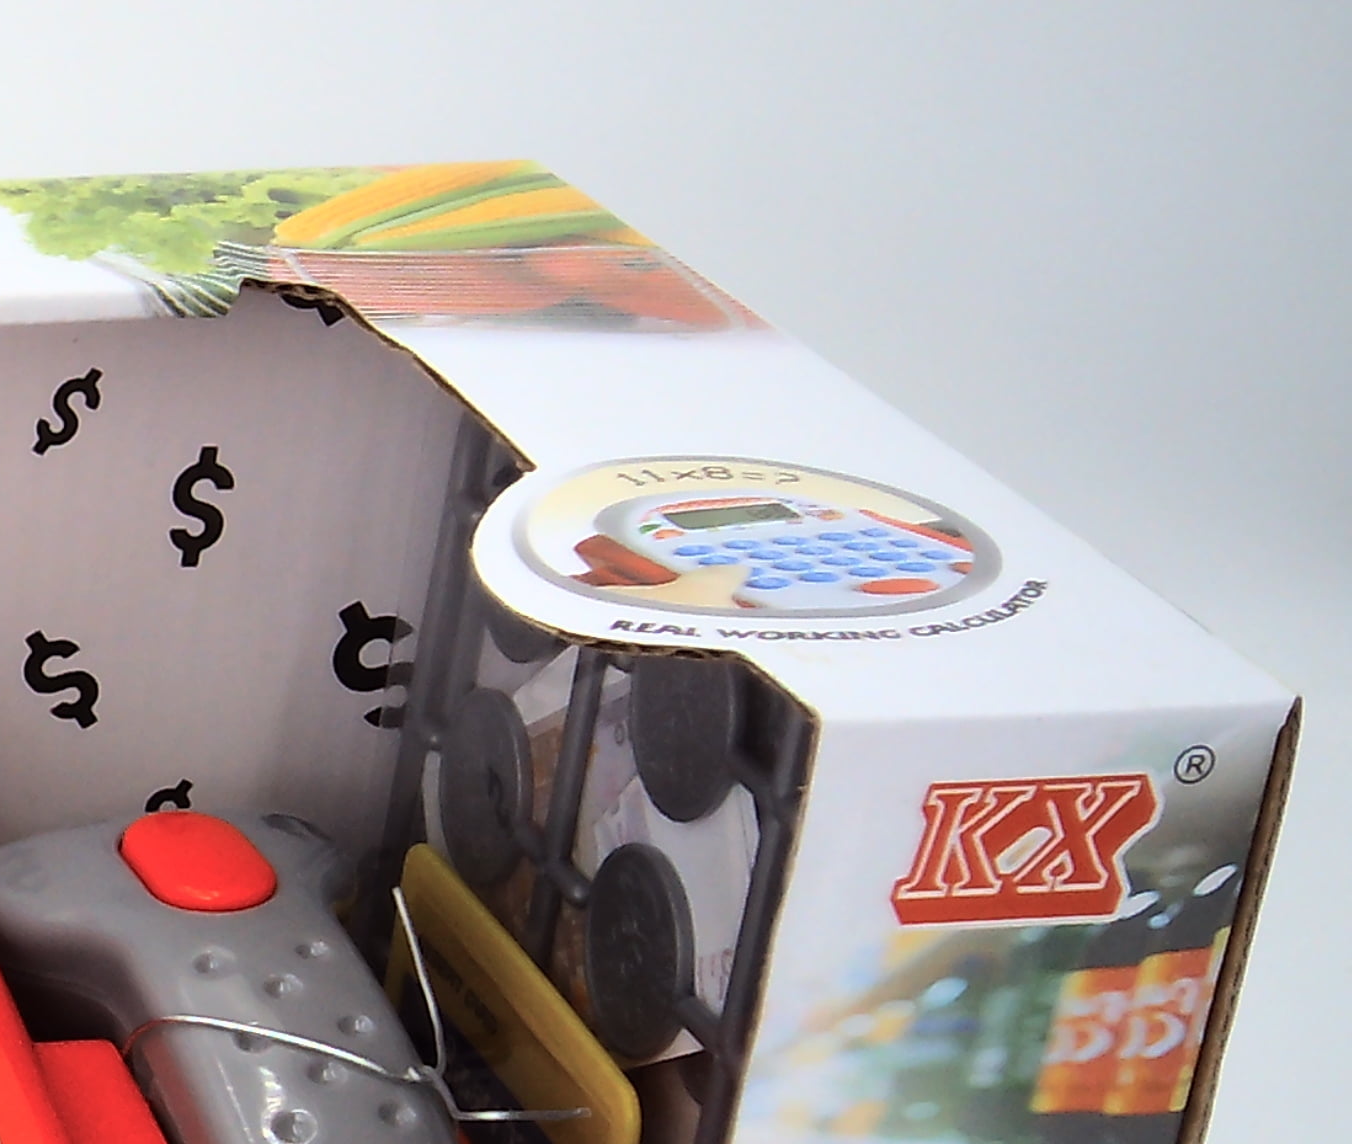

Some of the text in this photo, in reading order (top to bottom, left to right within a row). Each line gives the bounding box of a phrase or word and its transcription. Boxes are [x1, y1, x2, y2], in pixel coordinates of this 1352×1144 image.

[609, 575, 1050, 642] REAL WORKING CALCULATOR
[893, 775, 1152, 912] KX
